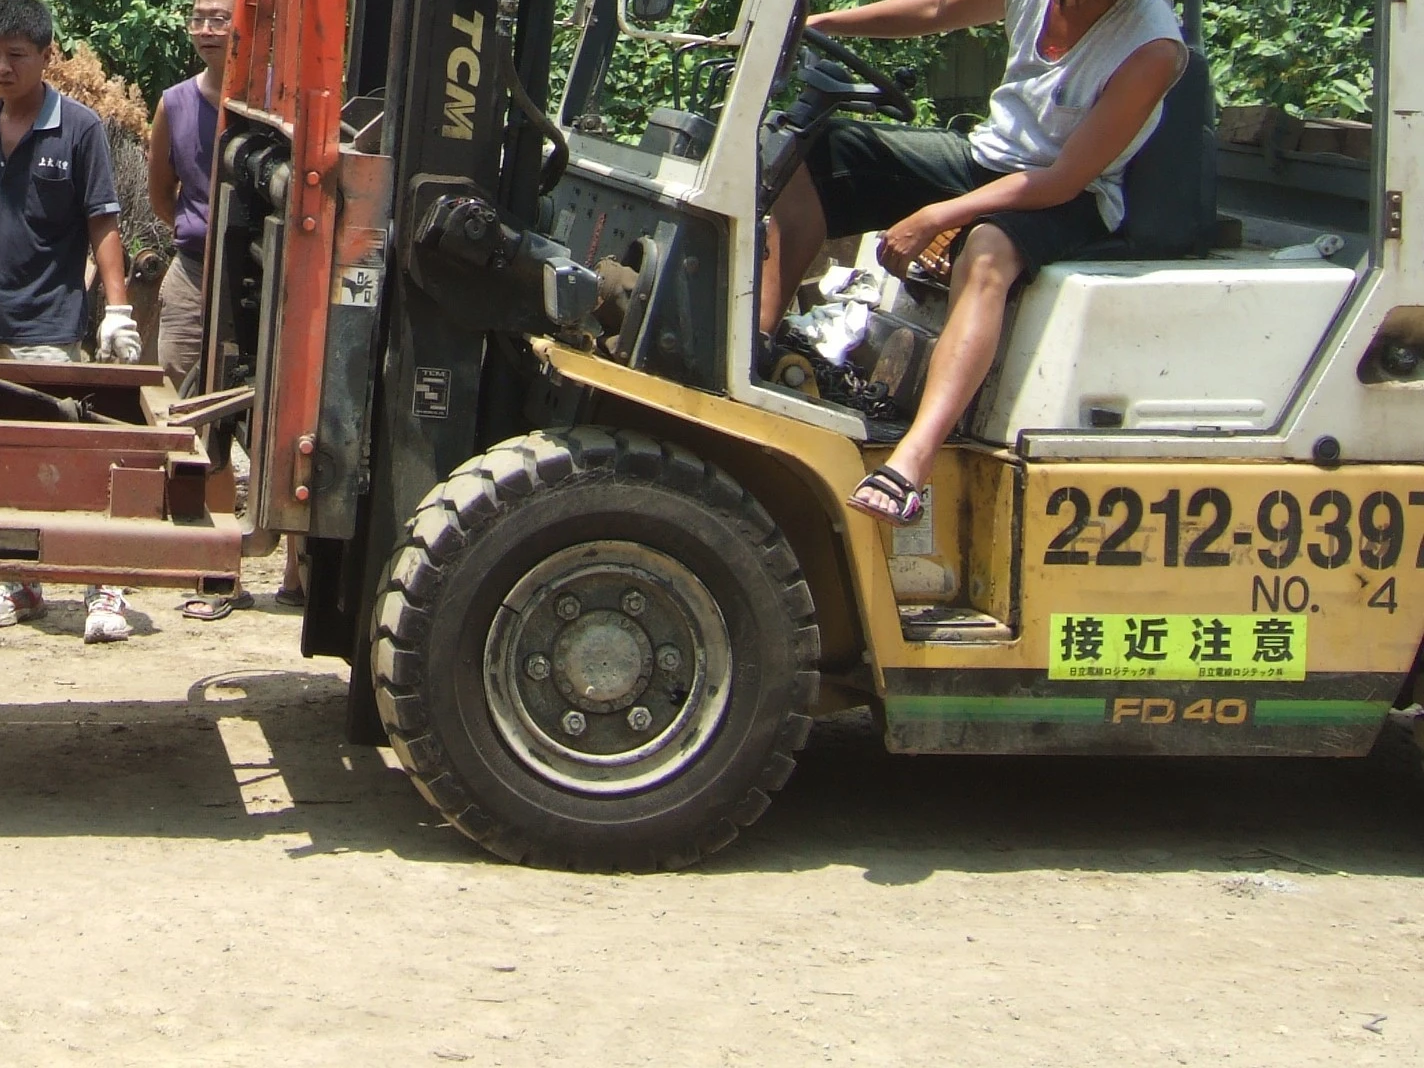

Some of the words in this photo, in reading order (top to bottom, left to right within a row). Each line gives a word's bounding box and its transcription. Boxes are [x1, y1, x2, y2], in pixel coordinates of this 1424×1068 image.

[441, 9, 485, 141] TCM
[1251, 574, 1320, 614] NO.
[1366, 575, 1399, 615] 4
[1061, 617, 1294, 662] 接近注意
